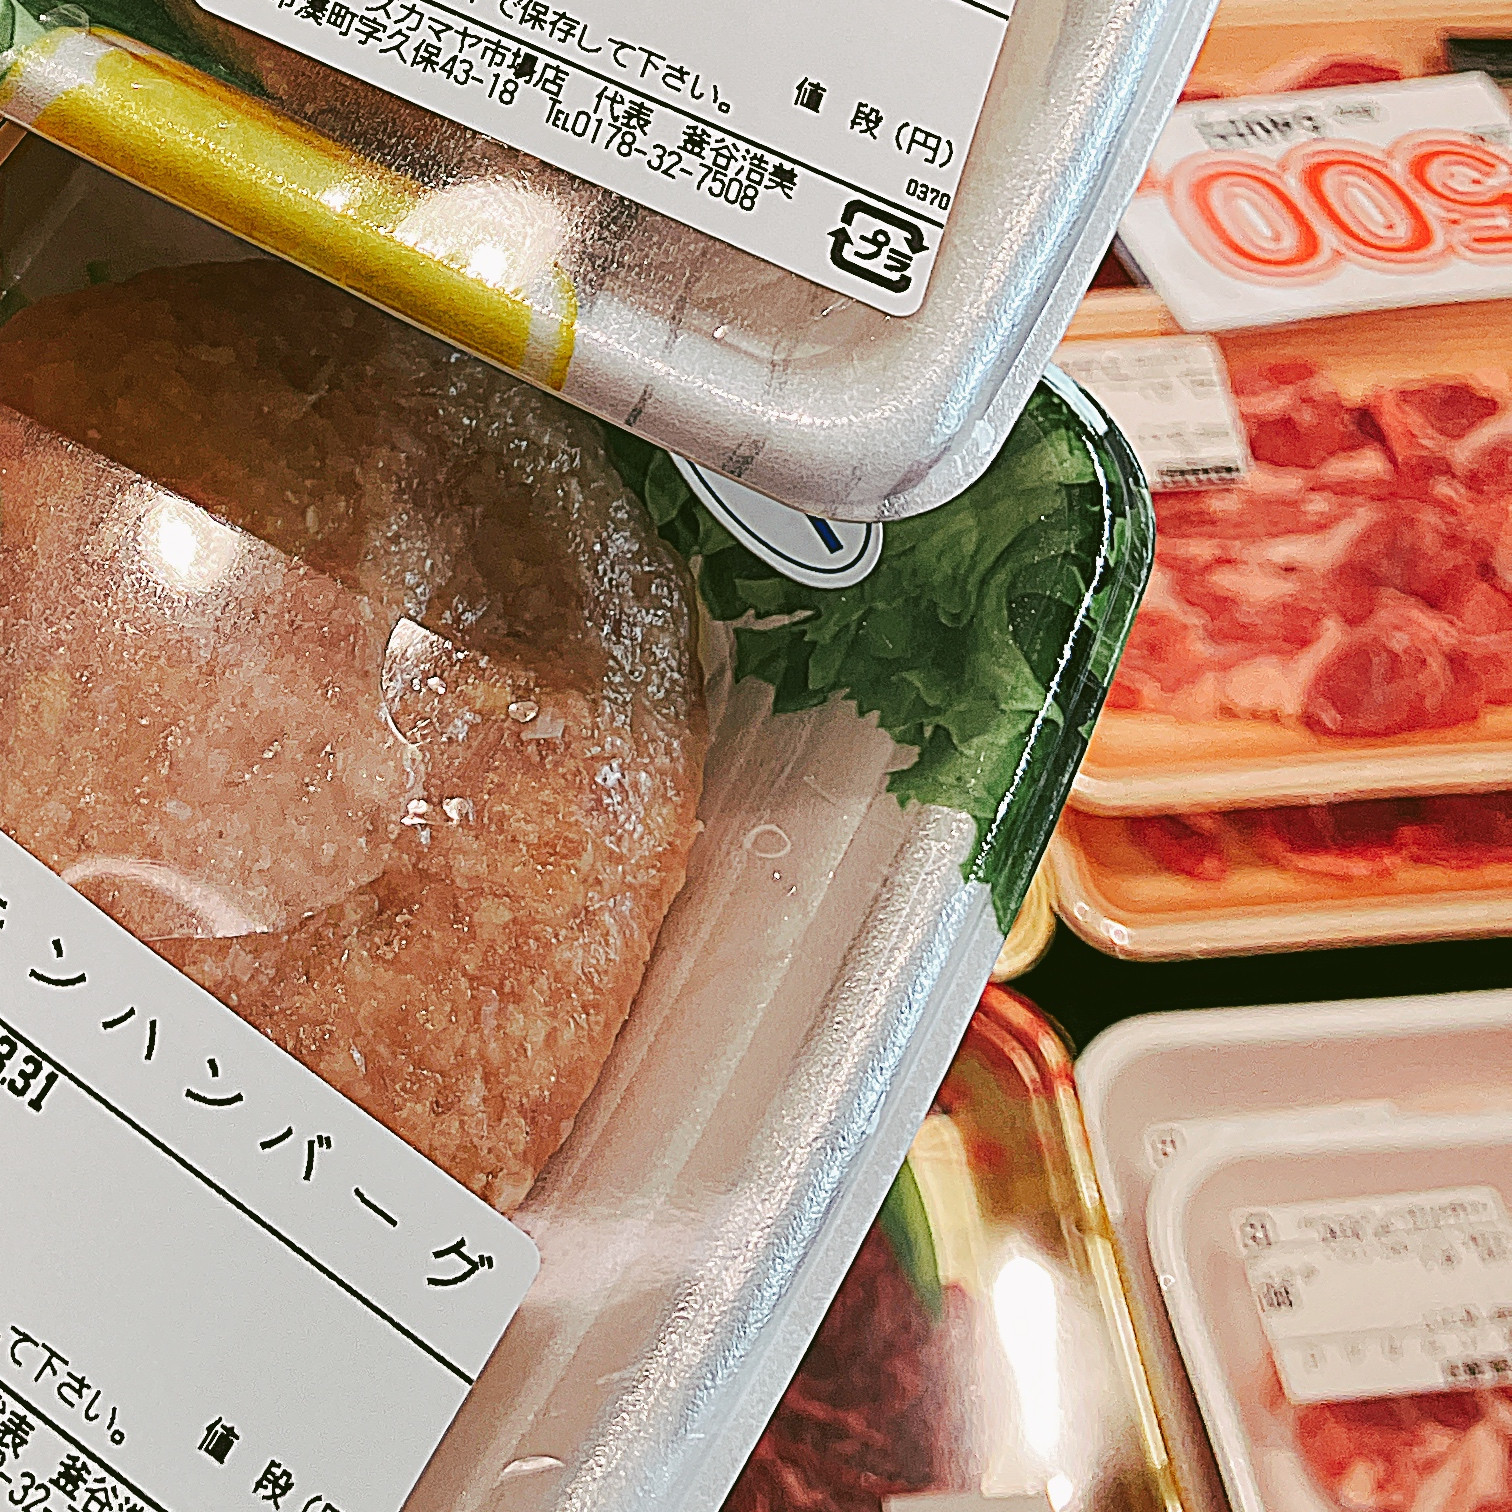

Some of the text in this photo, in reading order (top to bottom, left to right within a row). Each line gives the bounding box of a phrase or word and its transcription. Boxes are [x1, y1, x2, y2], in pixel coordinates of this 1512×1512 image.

[585, 85, 655, 137] 代表
[905, 178, 952, 211] 0370
[853, 228, 914, 273] プラ
